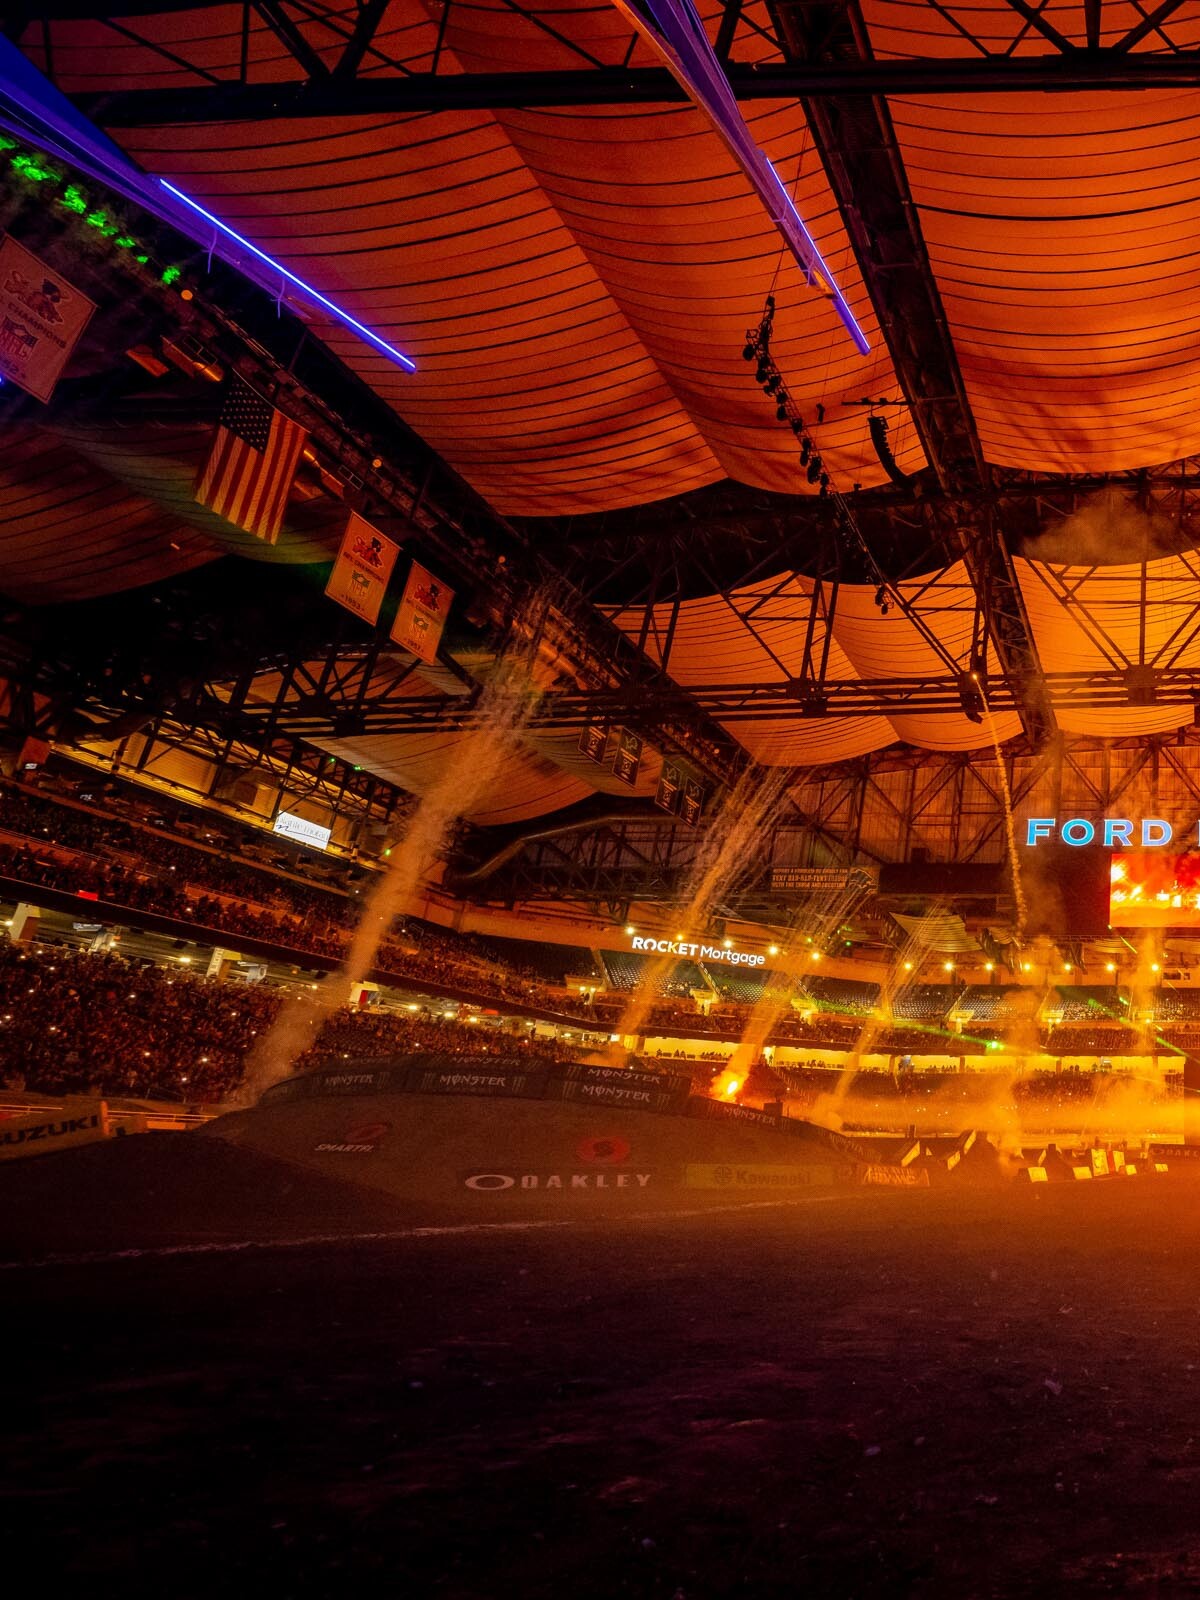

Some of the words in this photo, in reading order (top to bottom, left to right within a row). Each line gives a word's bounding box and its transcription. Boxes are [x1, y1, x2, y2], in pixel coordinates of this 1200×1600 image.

[7, 301, 67, 349] CHAMPIONS
[1026, 818, 1172, 847] FORD
[632, 937, 698, 956] ROCKET
[700, 945, 765, 966] Mortgage
[325, 1073, 375, 1087] MONSTER
[439, 1073, 506, 1088] MONSTER
[587, 1067, 662, 1085] MONSTER
[582, 1083, 650, 1103] MONSTER
[723, 1105, 777, 1126] MONSTER
[0, 1115, 98, 1144] UZUKI
[521, 1174, 652, 1189] OAKLEY
[735, 1169, 811, 1186] Kawasaki
